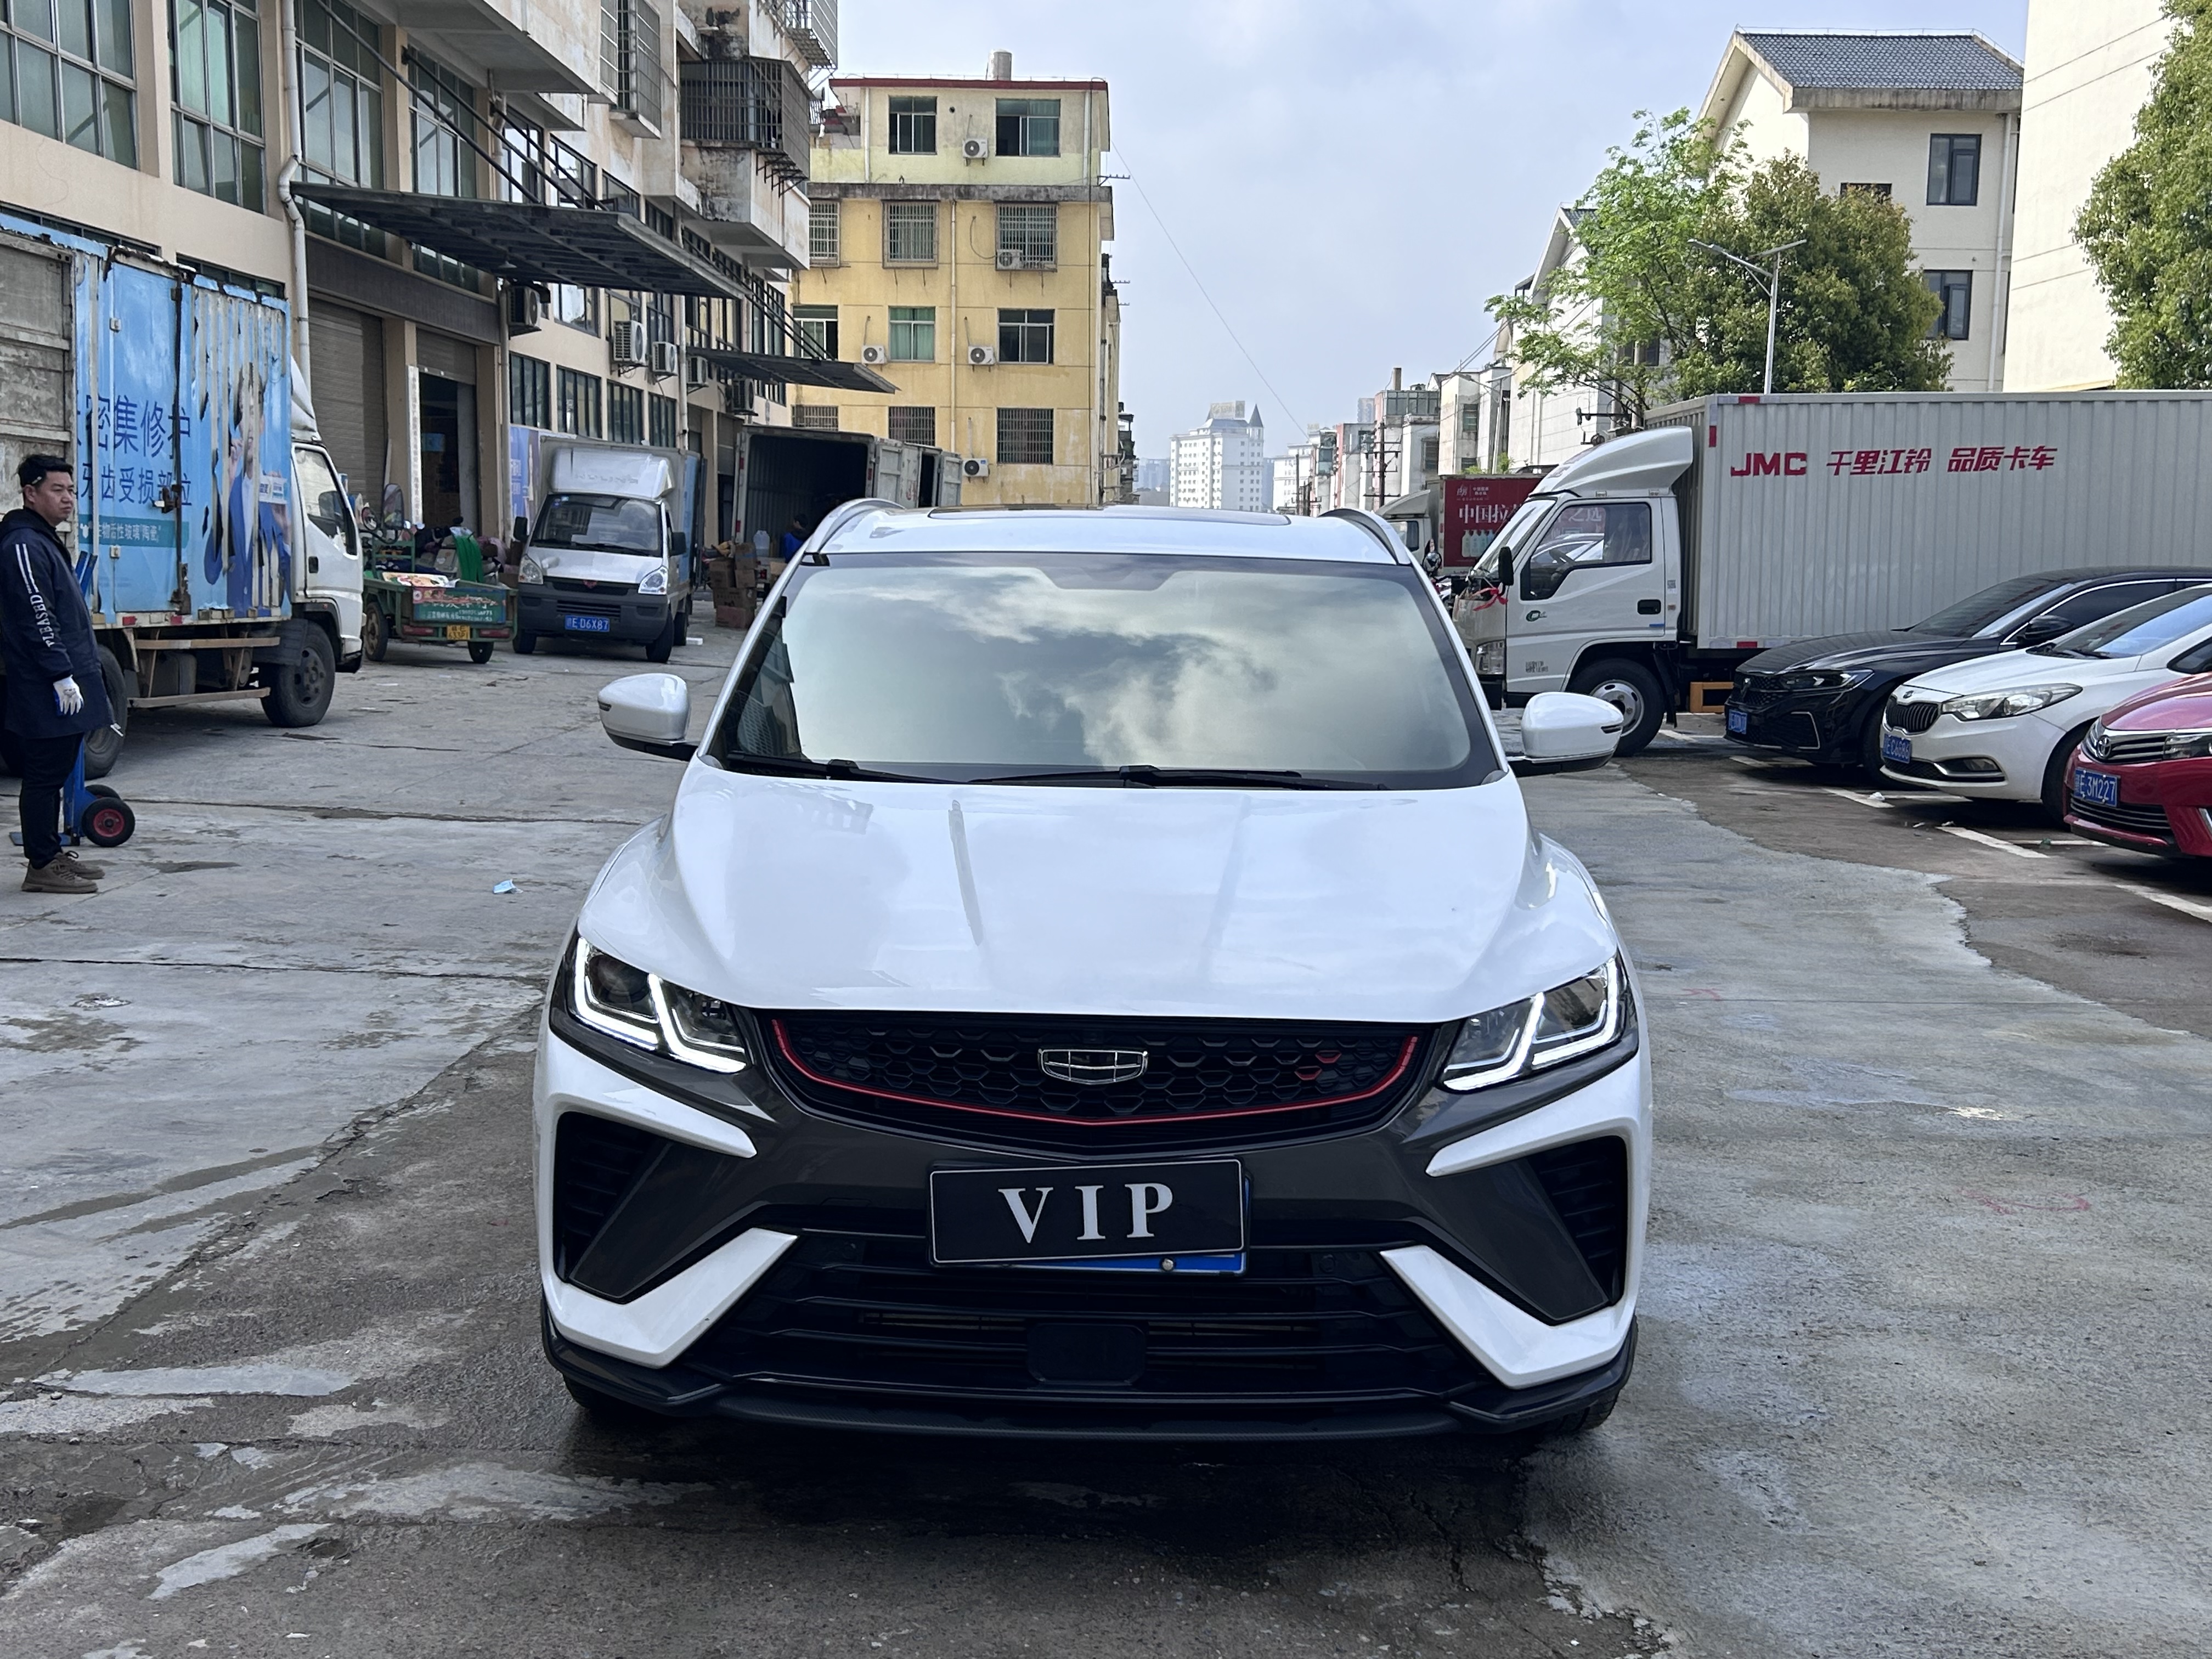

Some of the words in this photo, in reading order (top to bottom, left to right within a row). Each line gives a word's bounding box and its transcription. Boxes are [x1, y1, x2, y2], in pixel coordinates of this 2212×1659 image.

[77, 394, 191, 459] 密集修护
[1731, 452, 1807, 476] JMC
[1826, 448, 1932, 476] 千里江铃
[1947, 445, 2058, 472] 品质卡车
[30, 594, 55, 648] PLEASED
[998, 1182, 1173, 1244] VIP
